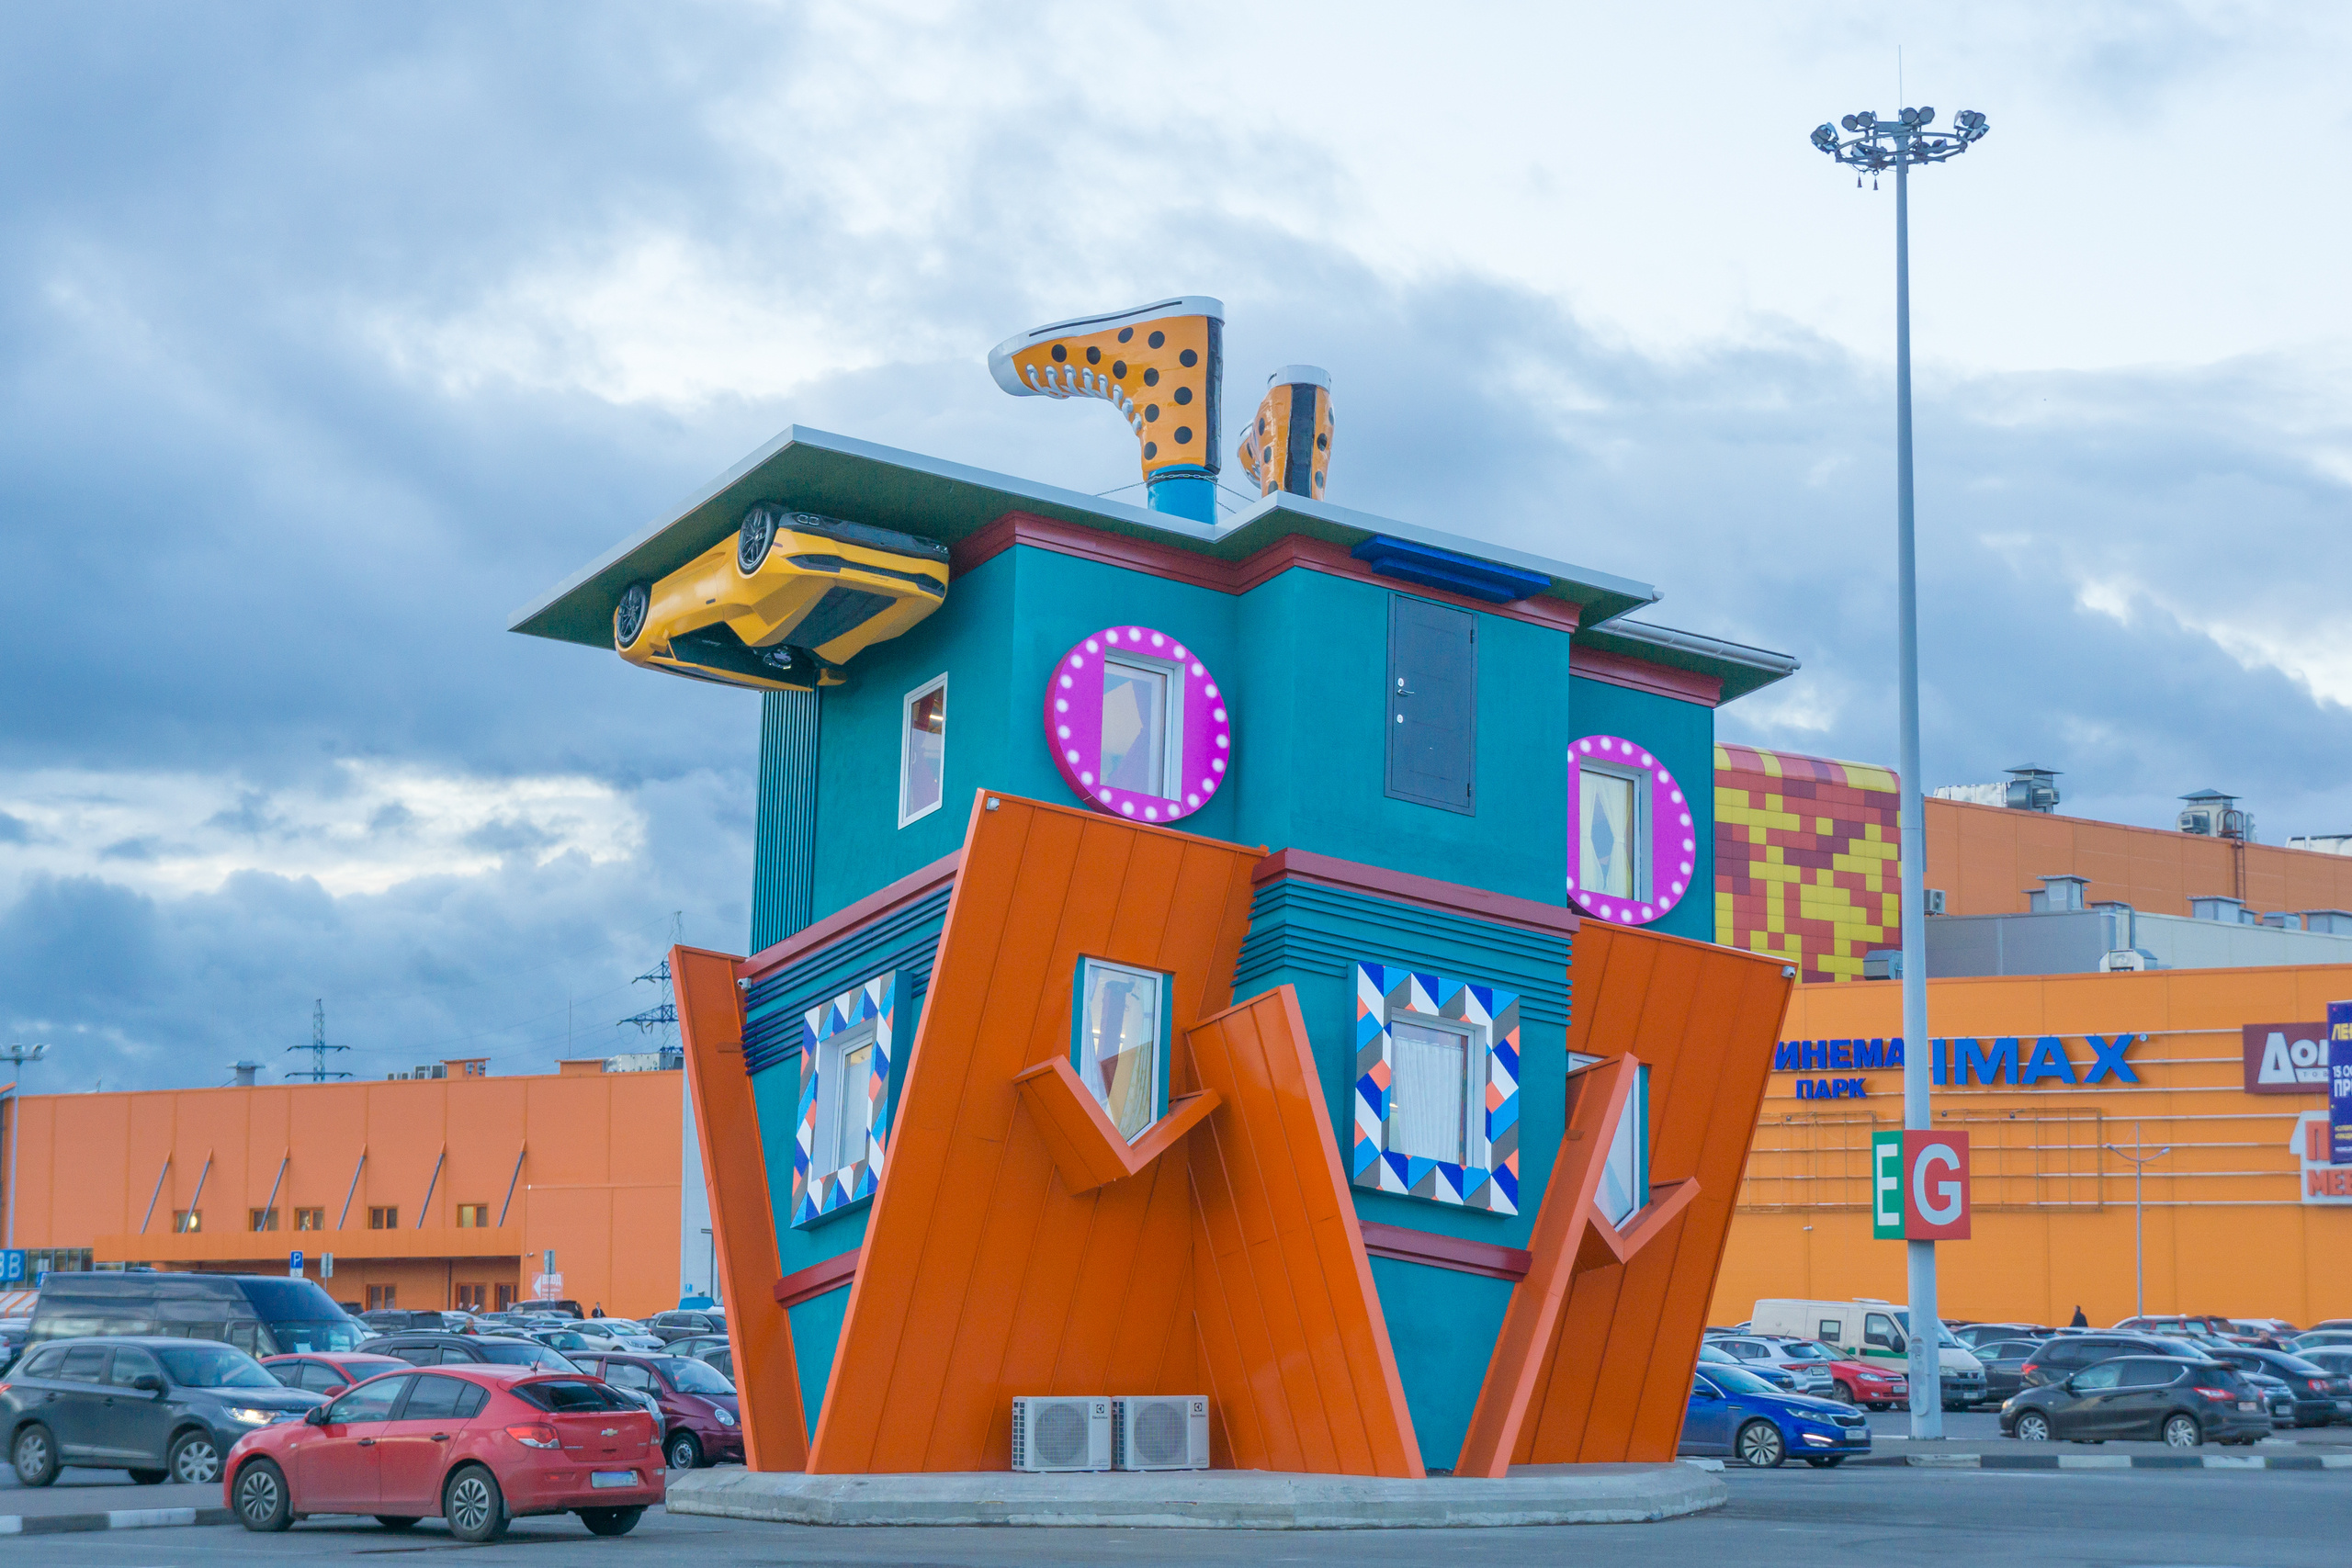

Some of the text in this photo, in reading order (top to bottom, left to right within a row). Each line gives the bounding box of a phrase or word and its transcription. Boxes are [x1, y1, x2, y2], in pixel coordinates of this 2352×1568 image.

[2331, 1023, 2352, 1041] ЛЕ
[1932, 1034, 2139, 1085] IMAX
[1796, 1077, 1867, 1100] ПАРК
[2334, 1078, 2352, 1098] ПР
[1876, 1144, 1900, 1226] E
[1913, 1143, 1962, 1226] G
[2306, 1168, 2352, 1196] МЕ
